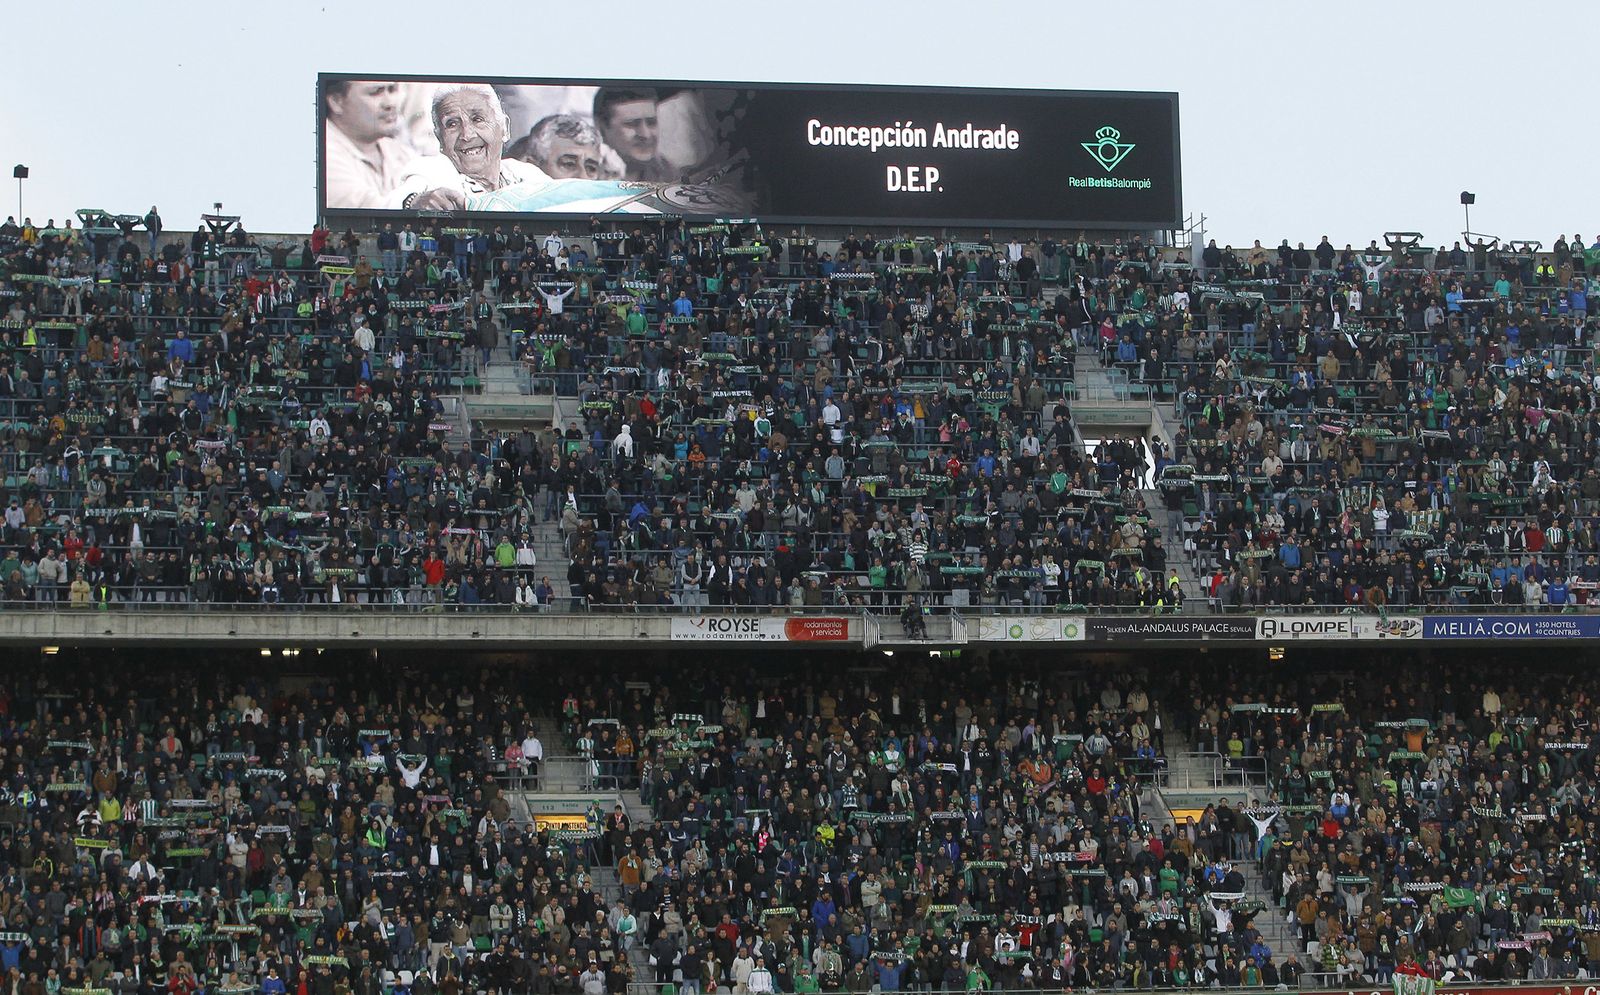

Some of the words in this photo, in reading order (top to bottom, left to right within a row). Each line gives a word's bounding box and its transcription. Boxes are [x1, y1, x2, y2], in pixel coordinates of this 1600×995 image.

[807, 119, 927, 152] Concepción
[932, 122, 1020, 151] Andrade
[886, 165, 944, 193] D.E.P.
[708, 618, 759, 632] ROYSE
[803, 620, 843, 628] rodamientos
[1127, 623, 1190, 633] AL-ANDALUS
[1192, 623, 1229, 633] PALACE
[1550, 621, 1577, 629] HOTELS
[815, 628, 842, 636] servicios
